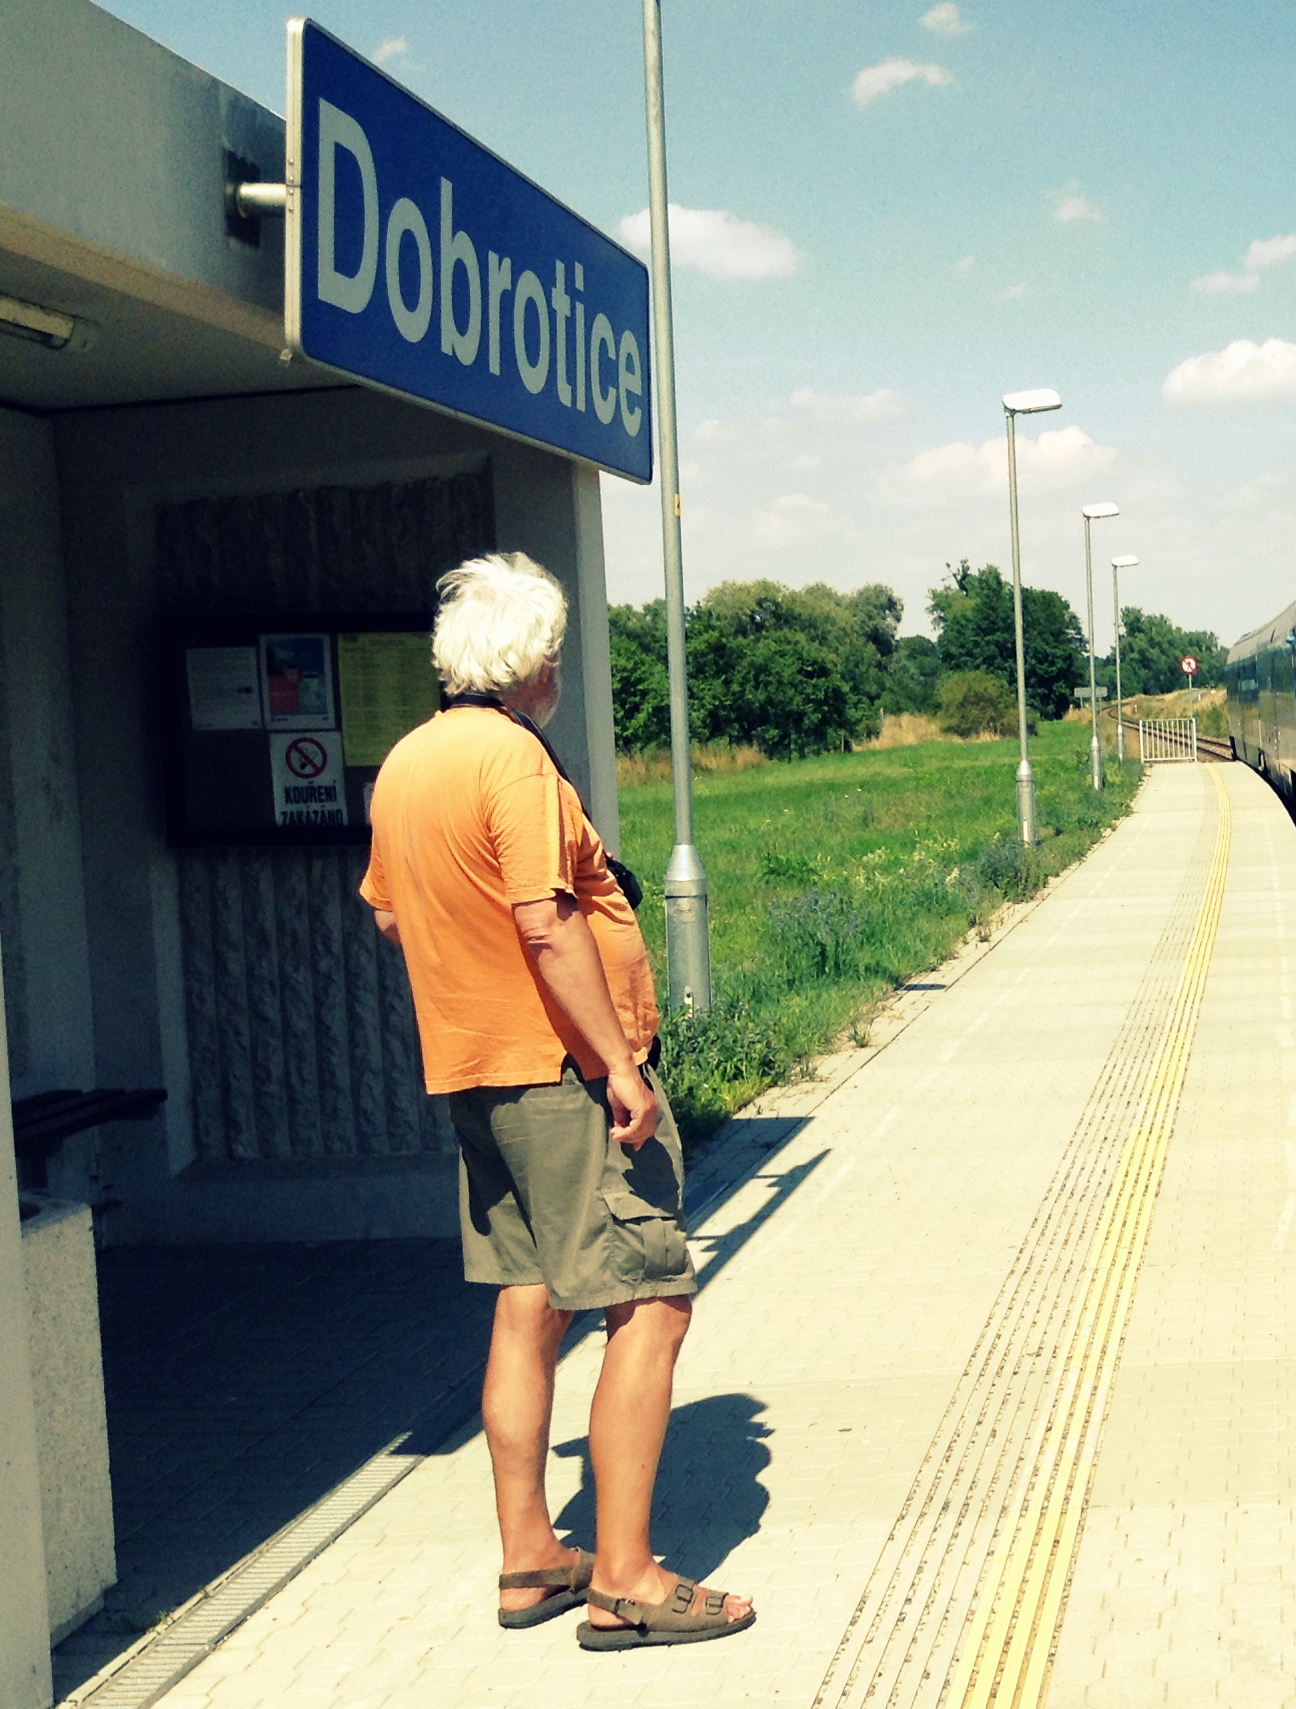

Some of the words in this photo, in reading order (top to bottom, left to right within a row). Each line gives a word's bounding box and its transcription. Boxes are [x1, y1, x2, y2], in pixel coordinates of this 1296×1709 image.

[318, 97, 642, 437] Dobrotice
[284, 780, 337, 804] KOUŘENÍ
[281, 805, 344, 826] ZAKÁZÁNO
